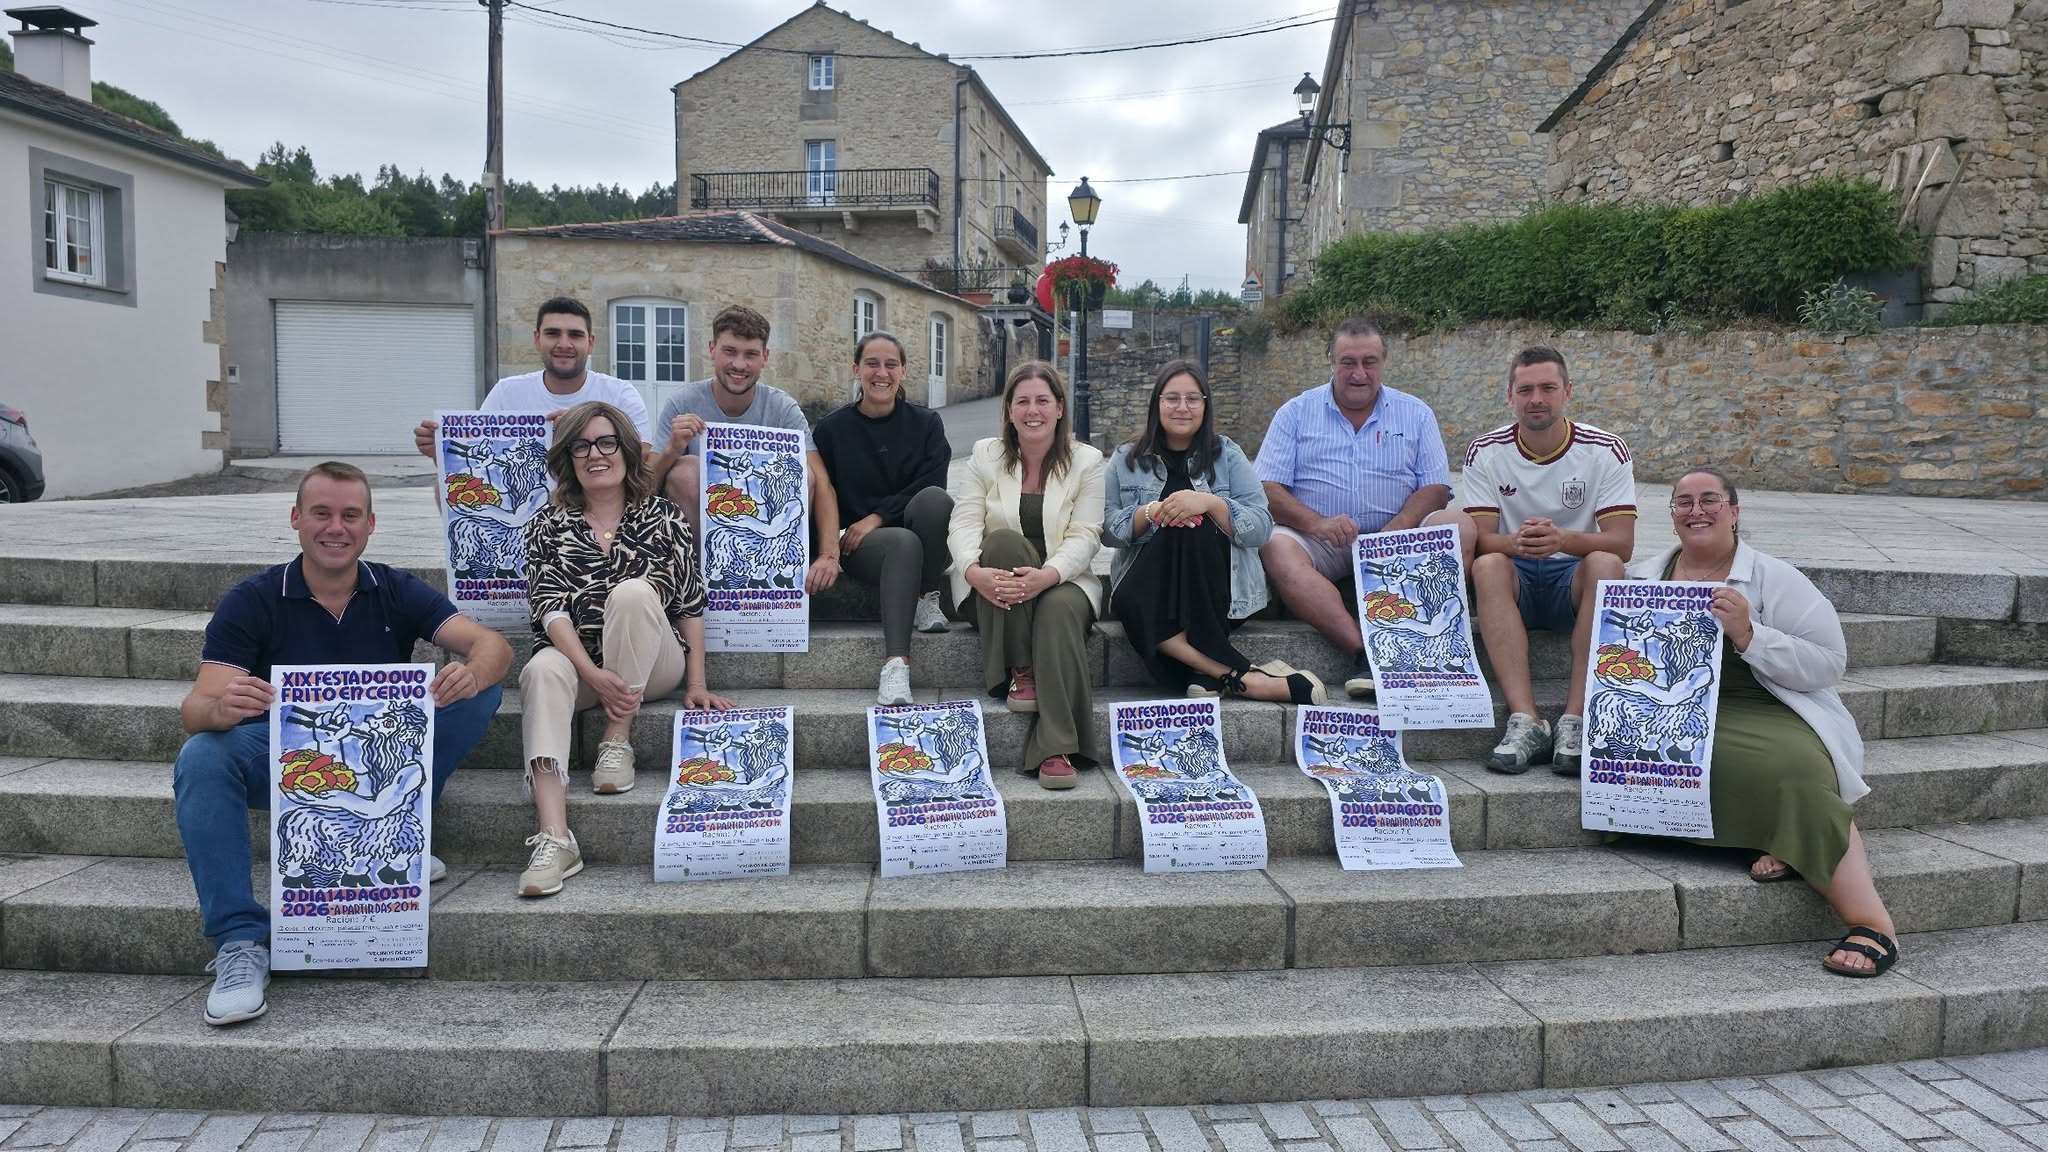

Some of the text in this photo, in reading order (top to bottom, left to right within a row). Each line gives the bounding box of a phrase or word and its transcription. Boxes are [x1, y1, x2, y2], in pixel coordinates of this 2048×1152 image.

[442, 415, 545, 426] XIX FESTA DO OVO
[442, 427, 480, 438] FRITO
[502, 427, 546, 437] CERVO
[707, 428, 799, 443] XIX FESTA DO OVO
[707, 439, 742, 449] FRITO
[762, 442, 800, 453] CERVO
[1359, 529, 1453, 549] XIX FESTA DO OVO
[1359, 547, 1394, 560] FRITO
[1414, 540, 1454, 553] CERVO
[456, 580, 464, 589] O
[1605, 585, 1628, 596] XIX
[1629, 585, 1663, 597] FESTA
[1665, 586, 1685, 597] DO
[457, 591, 489, 600] 2026
[708, 590, 717, 599] O
[740, 590, 751, 600] 14
[760, 590, 804, 600] AGOSTO
[709, 601, 740, 611] 2026
[784, 601, 794, 609] 20
[1603, 597, 1644, 608] FRITO
[282, 670, 426, 687] XIX FESTA DO OVO
[1383, 680, 1416, 689] 2026
[281, 687, 336, 702] FRITO
[366, 685, 426, 700] CERVO
[1117, 703, 1214, 719] XIX FESTA DO OVO
[1305, 710, 1323, 722] XIX
[1325, 712, 1354, 724] FESTA
[1355, 714, 1371, 725] DO
[682, 716, 720, 725] FRITO
[743, 712, 786, 721] CERVO
[1117, 719, 1154, 731] FRITO
[1174, 715, 1214, 727] CERVO
[1303, 722, 1338, 734] FRITO
[1590, 759, 1599, 771] O
[1602, 760, 1624, 772] DIA
[1626, 762, 1639, 773] 14
[1650, 763, 1702, 777] AGOSTO
[1590, 771, 1627, 785] 2026
[1637, 777, 1662, 787] PARTIR
[1680, 779, 1692, 789] 20
[887, 808, 897, 816] O
[948, 799, 996, 810] AGOSTO
[1205, 801, 1253, 811] AGOSTO
[1341, 803, 1350, 814] O
[1352, 803, 1373, 815] DIA
[1374, 804, 1386, 815] 14
[1397, 804, 1443, 816] AGOSTO
[668, 815, 678, 823] O
[731, 809, 783, 819] AGOSTO
[889, 814, 926, 827] 2026
[977, 809, 989, 818] 20
[1150, 813, 1186, 824] 2026
[1236, 811, 1247, 820] 20
[1343, 815, 1376, 827] 2026
[1424, 818, 1434, 827] 20
[666, 823, 706, 833] 2026
[760, 819, 772, 827] 20
[282, 889, 296, 902] O
[298, 889, 326, 902] DIA
[327, 889, 343, 902] 14
[358, 886, 422, 901] AGOSTO
[282, 902, 330, 916] 2026
[342, 903, 374, 915] PARTIR
[376, 902, 392, 914] DAS
[394, 901, 409, 912] 20
